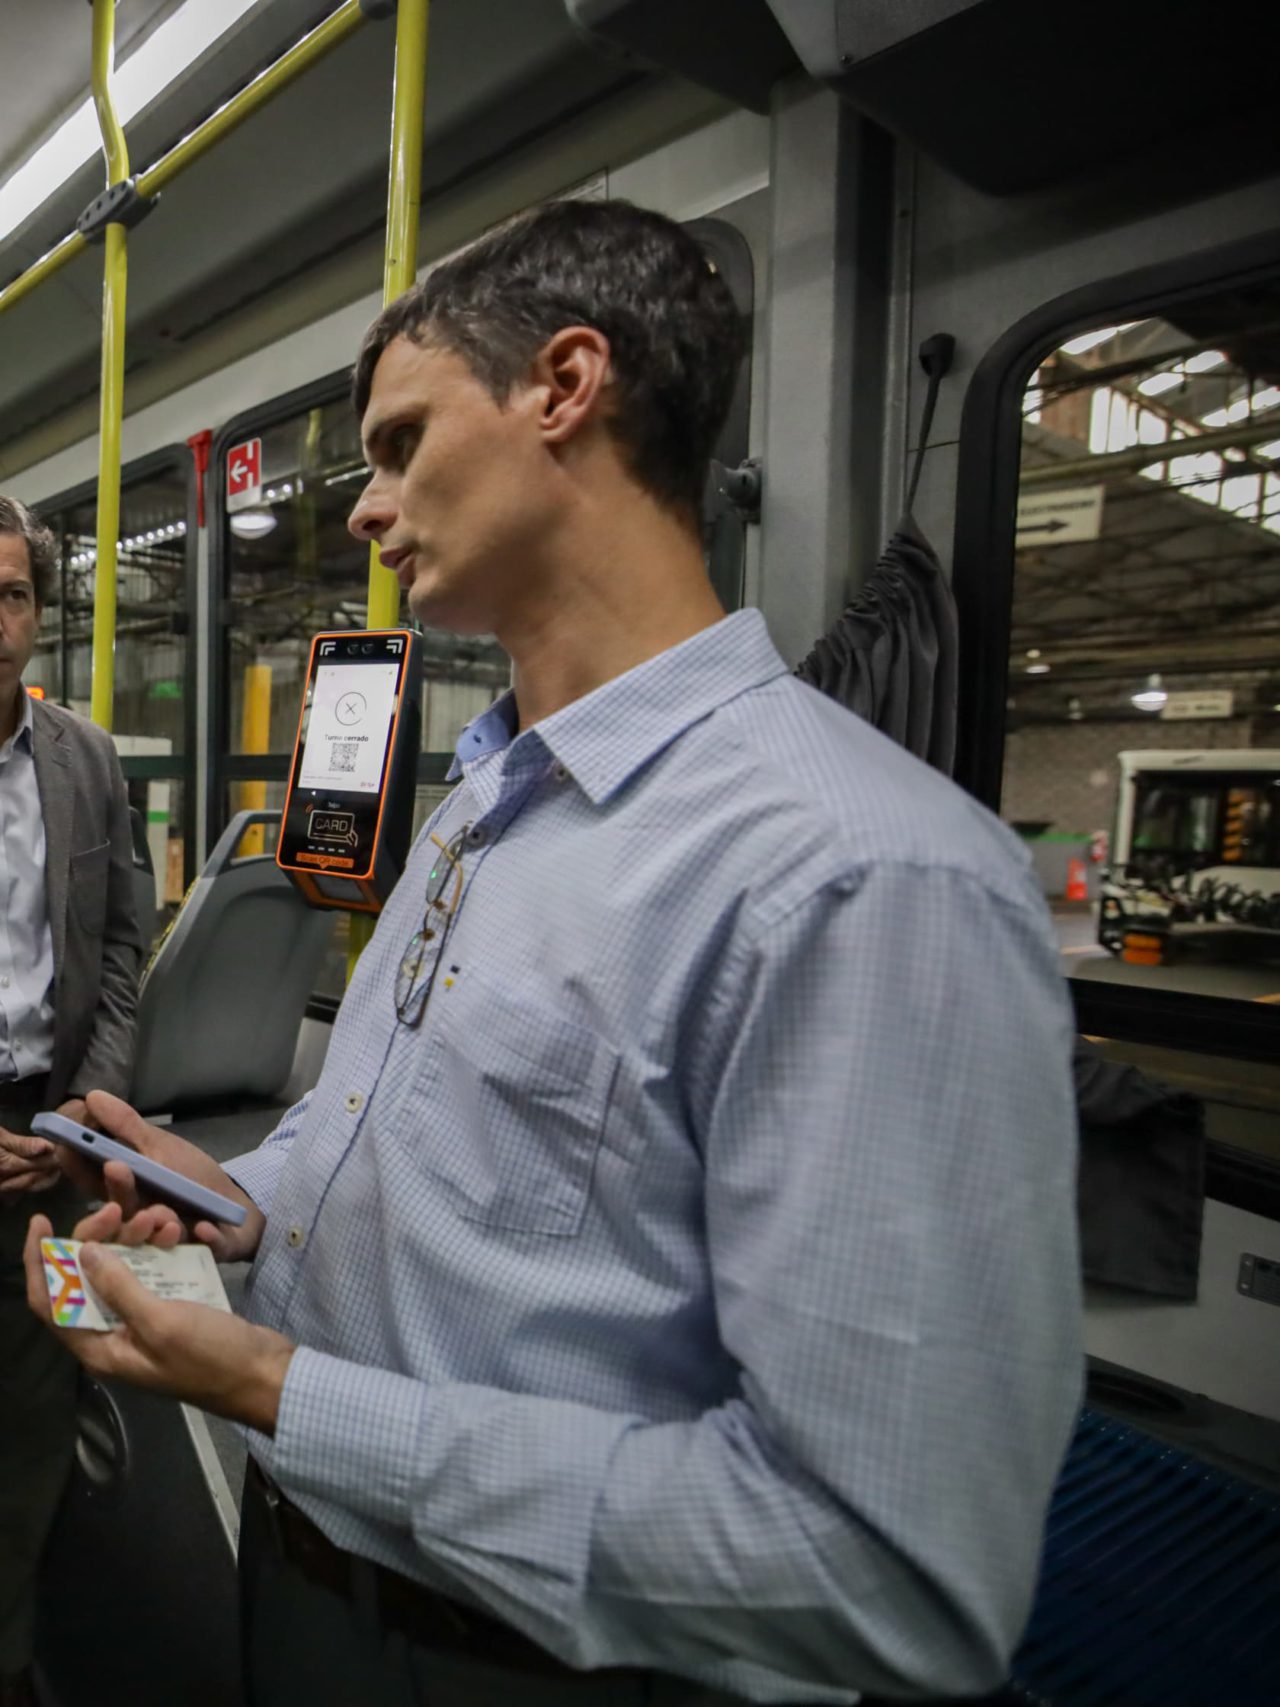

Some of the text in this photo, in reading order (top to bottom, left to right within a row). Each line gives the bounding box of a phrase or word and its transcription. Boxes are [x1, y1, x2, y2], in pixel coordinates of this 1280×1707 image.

[343, 735, 369, 743] cerrado
[315, 818, 348, 832] CARD
[301, 854, 349, 866] Scan QR code
